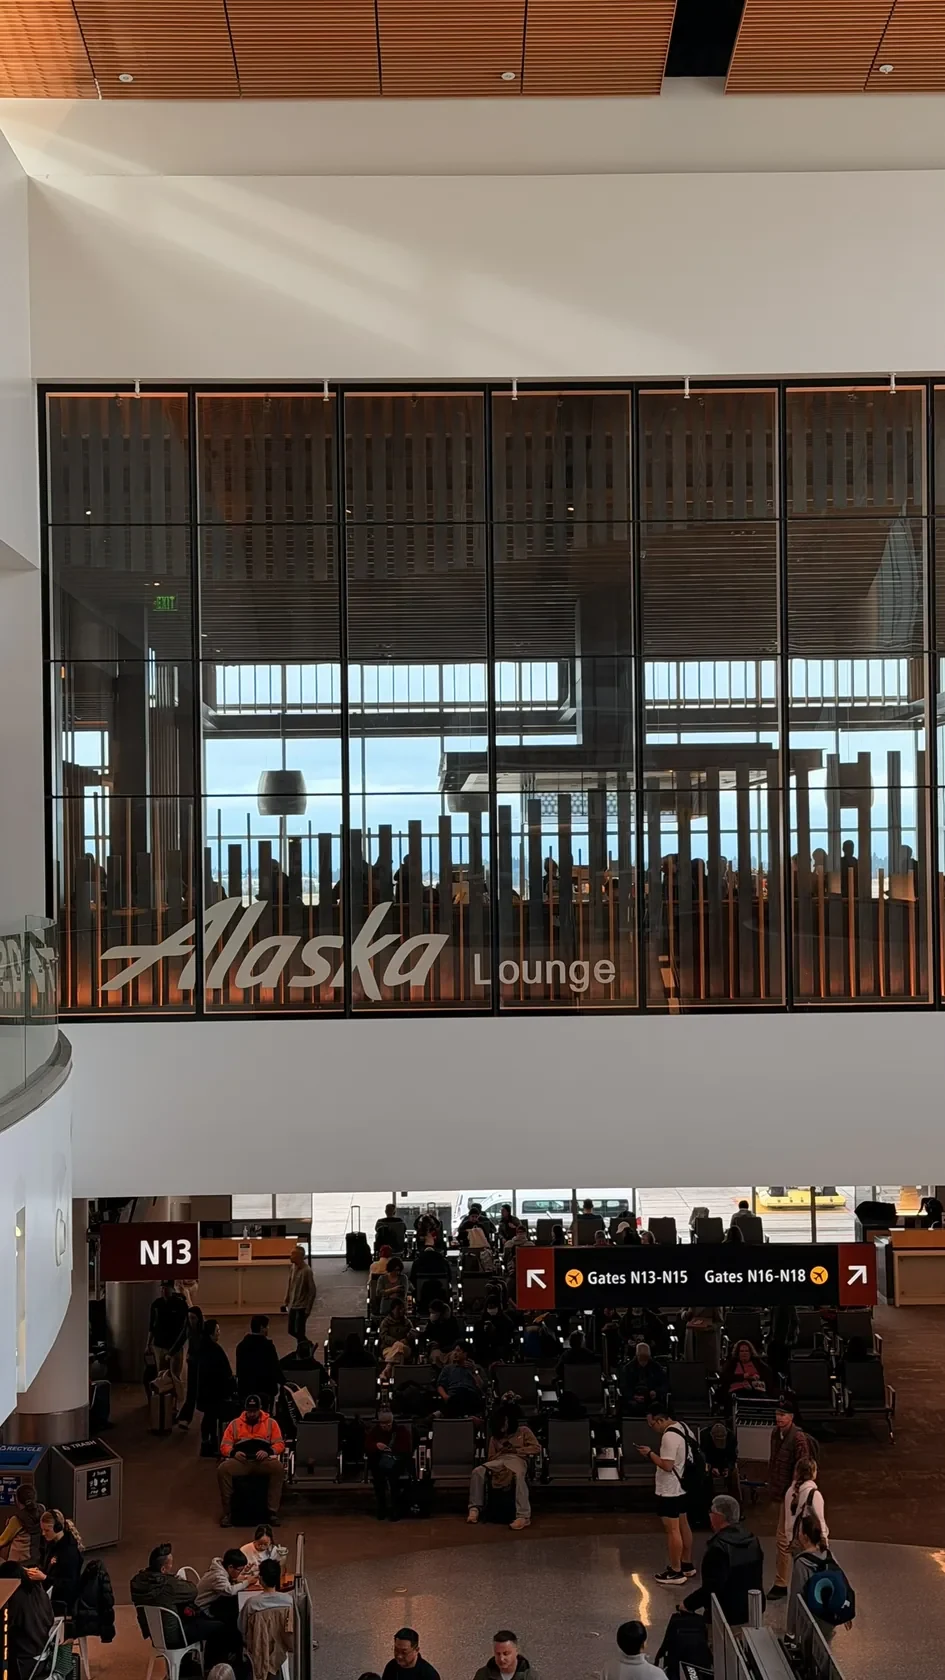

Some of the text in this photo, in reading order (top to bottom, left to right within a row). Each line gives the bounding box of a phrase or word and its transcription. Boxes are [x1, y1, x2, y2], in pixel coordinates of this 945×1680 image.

[100, 896, 449, 1001] Alaska
[473, 953, 616, 992] Lounge
[140, 1239, 192, 1266] N13
[587, 1270, 688, 1285] Gates N13-N15
[704, 1268, 806, 1284] Gates N16-N18
[71, 1440, 97, 1449] TRASH
